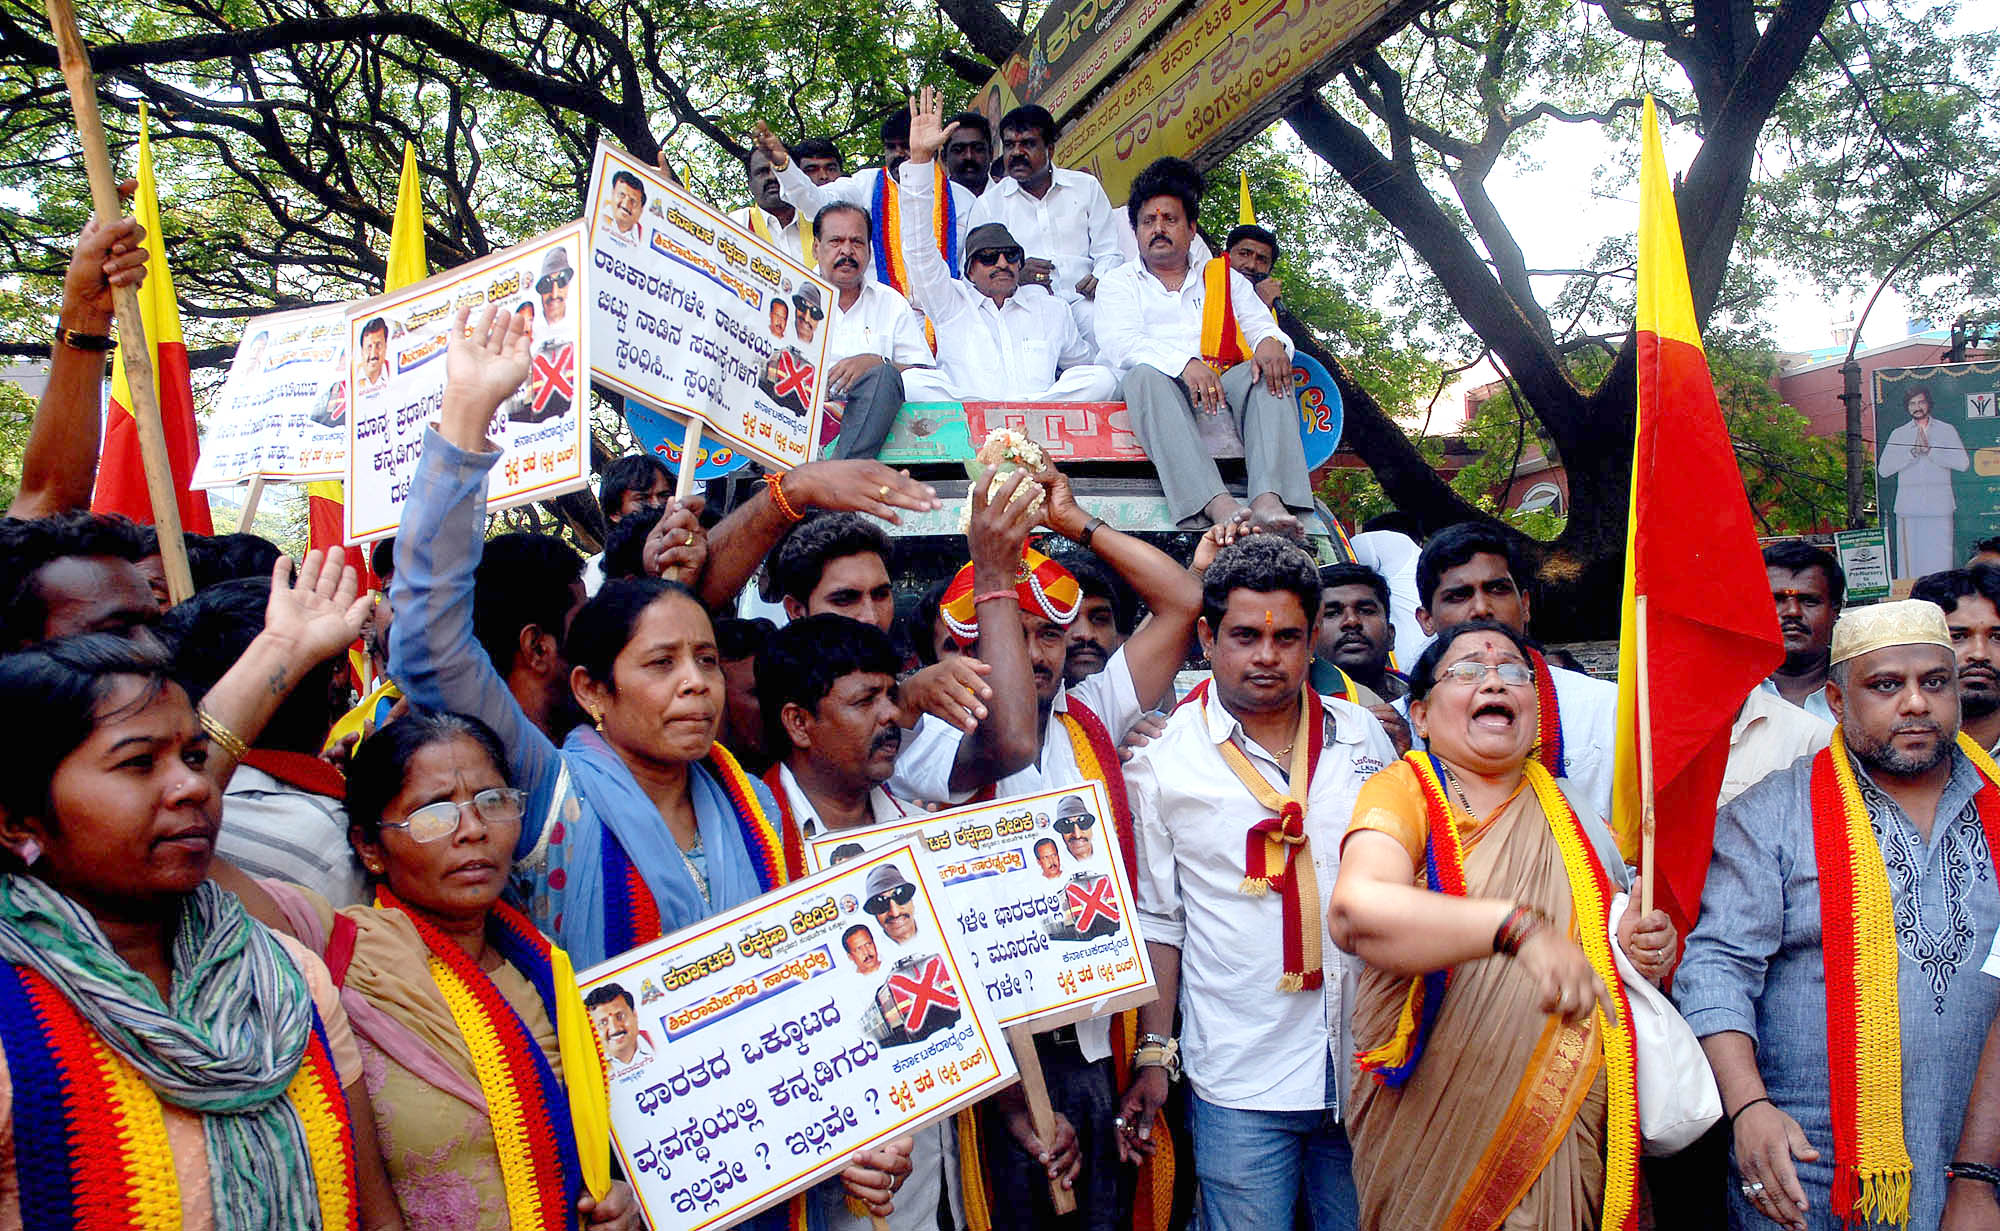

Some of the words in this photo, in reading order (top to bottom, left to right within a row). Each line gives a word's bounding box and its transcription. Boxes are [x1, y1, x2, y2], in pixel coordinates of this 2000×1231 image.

[667, 207, 715, 246] ಕರ್ನಾಟಕ
[717, 236, 748, 266] ರಕ್ಷಣಾ
[750, 256, 781, 286] ವೇದಿಕೆ
[598, 290, 629, 334] ಬಿಟ್ಟು
[636, 309, 683, 346] ನಾಡಿನ
[689, 333, 758, 389] ಸಮಸ್ಯೆಗಳಿಗೆ
[715, 307, 773, 360] ರಾಜಕೀಯ
[357, 407, 390, 444] ಮಾನ್ಯ
[753, 399, 808, 436] ಕರ್ನಾಟಕದಾದ್ಯಂತ
[955, 824, 993, 850] ರಕ್ಷಣಾ
[995, 811, 1034, 837] ವೇದಿಕೆ
[994, 893, 1064, 928] ಭಾರತದಲ್ಲಿ
[662, 943, 736, 991] ಕರ್ನಾಟಕ
[738, 924, 788, 960] ರಕ್ಷಣಾ
[790, 897, 839, 936] ವೇದಿಕೆ
[986, 930, 1049, 963] ಮೂರನೇ
[1062, 936, 1129, 963] ಕರ್ನಾಟಕದಾದ್ಯಂತ
[668, 980, 758, 1031] ಶಿವರಾಮೇಗೌಡ
[763, 951, 829, 989] ಸಾರಥ್ಯದಲ್ಲಿ
[635, 1046, 732, 1117] ಭಾರತದ
[741, 996, 841, 1064] ಒಕ್ಕೂಟದ
[892, 1024, 975, 1073] ಕರ್ನಾಟಕದಾದ್ಯಂತ
[914, 1068, 935, 1093] ತಡೆ
[633, 1098, 765, 1181] ವ್ಯವಸ್ಥೆಯಲ್ಲಿ
[768, 1037, 879, 1107] ಕನ್ನಡಿಗರು
[670, 1159, 748, 1213] ಇಲ್ಲವೇ
[754, 1142, 771, 1170] ?
[785, 1104, 858, 1156] ಇಲ್ಲವೇ
[864, 1087, 881, 1115] ?
